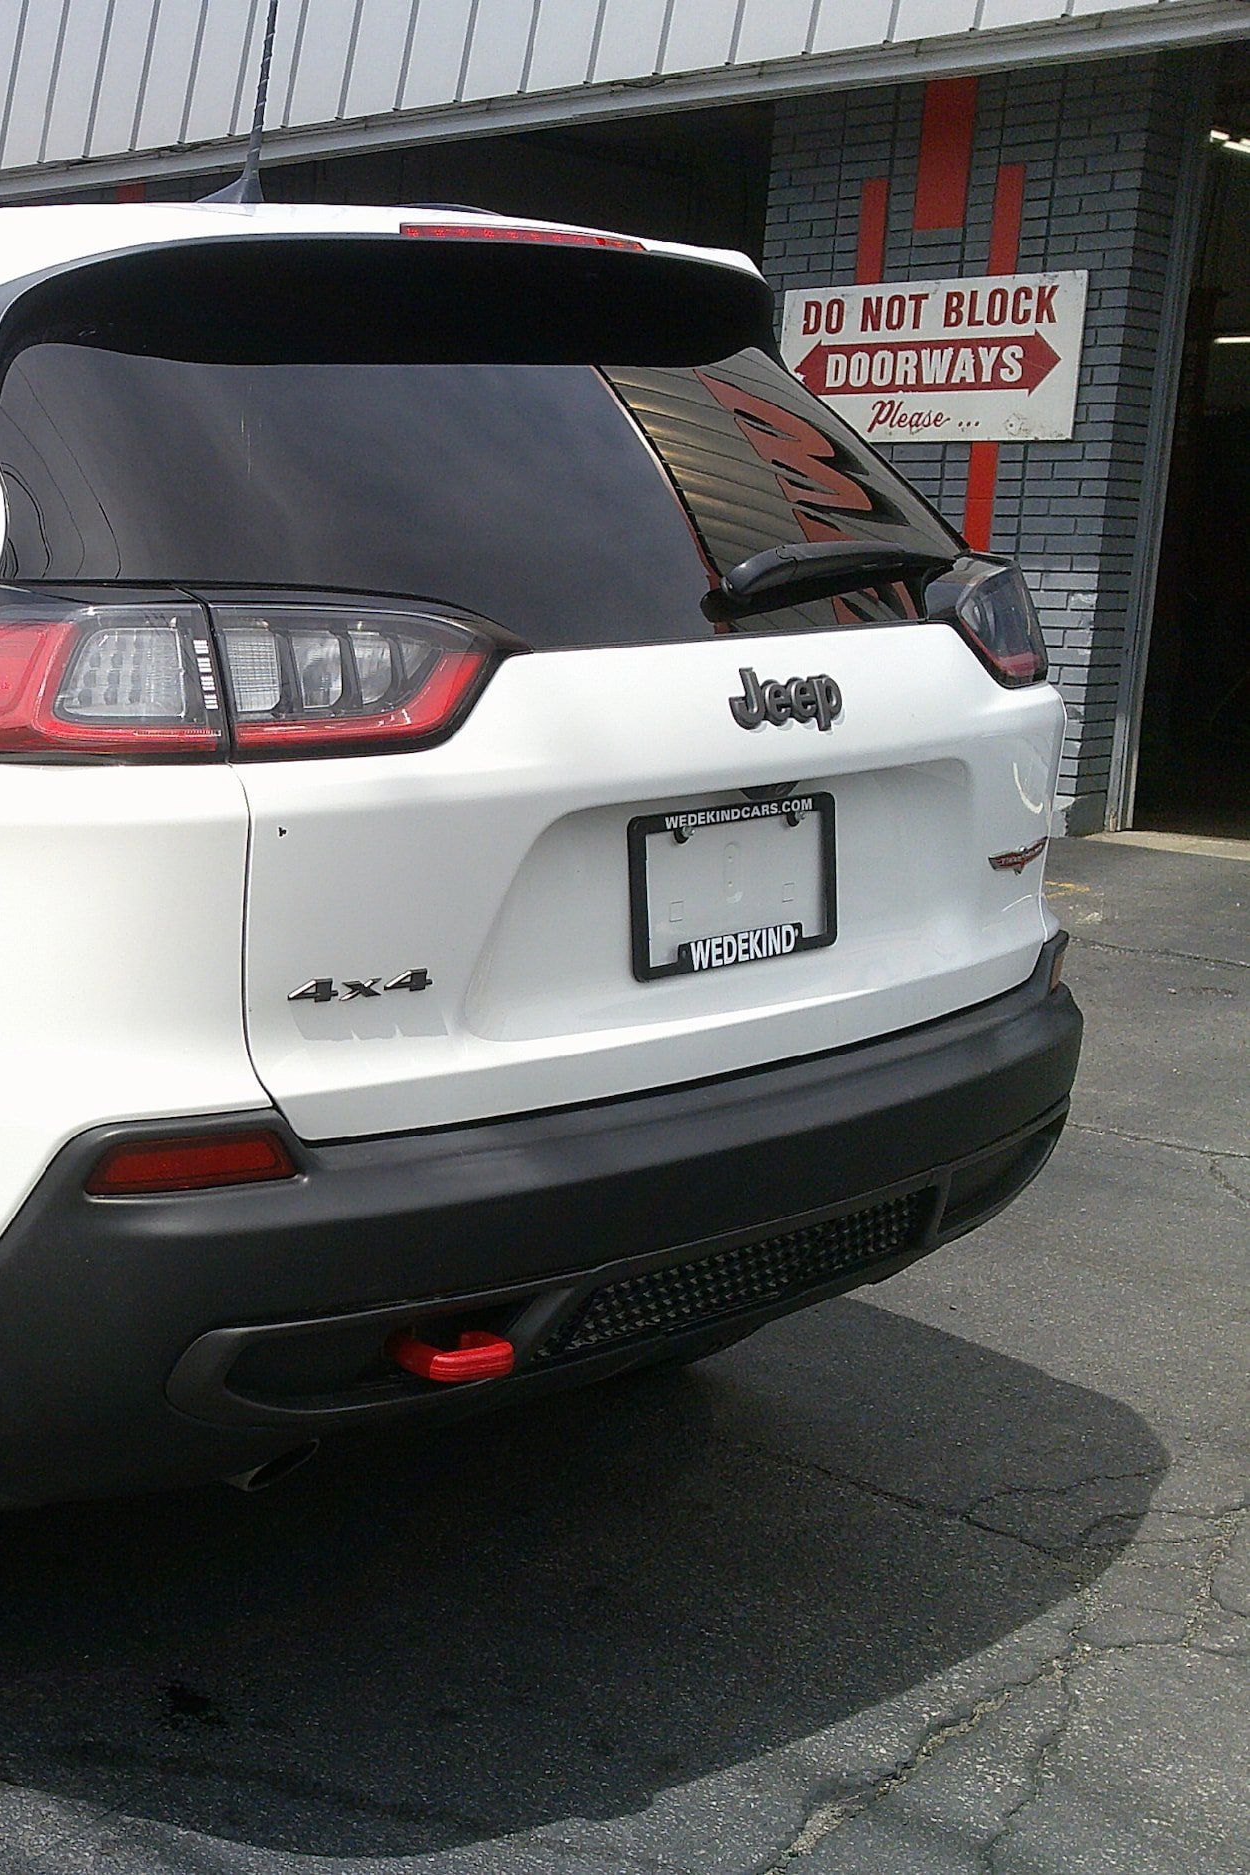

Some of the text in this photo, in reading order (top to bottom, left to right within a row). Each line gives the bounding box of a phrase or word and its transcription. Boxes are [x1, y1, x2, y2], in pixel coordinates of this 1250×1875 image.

[802, 285, 1060, 335] DO NOT BLOCK
[825, 345, 1024, 388] DOORWAYS
[867, 399, 951, 433] Please
[728, 667, 842, 731] Jeep
[665, 797, 813, 830] WEDEKINDCARS.COM
[690, 924, 796, 971] WEDEKIND
